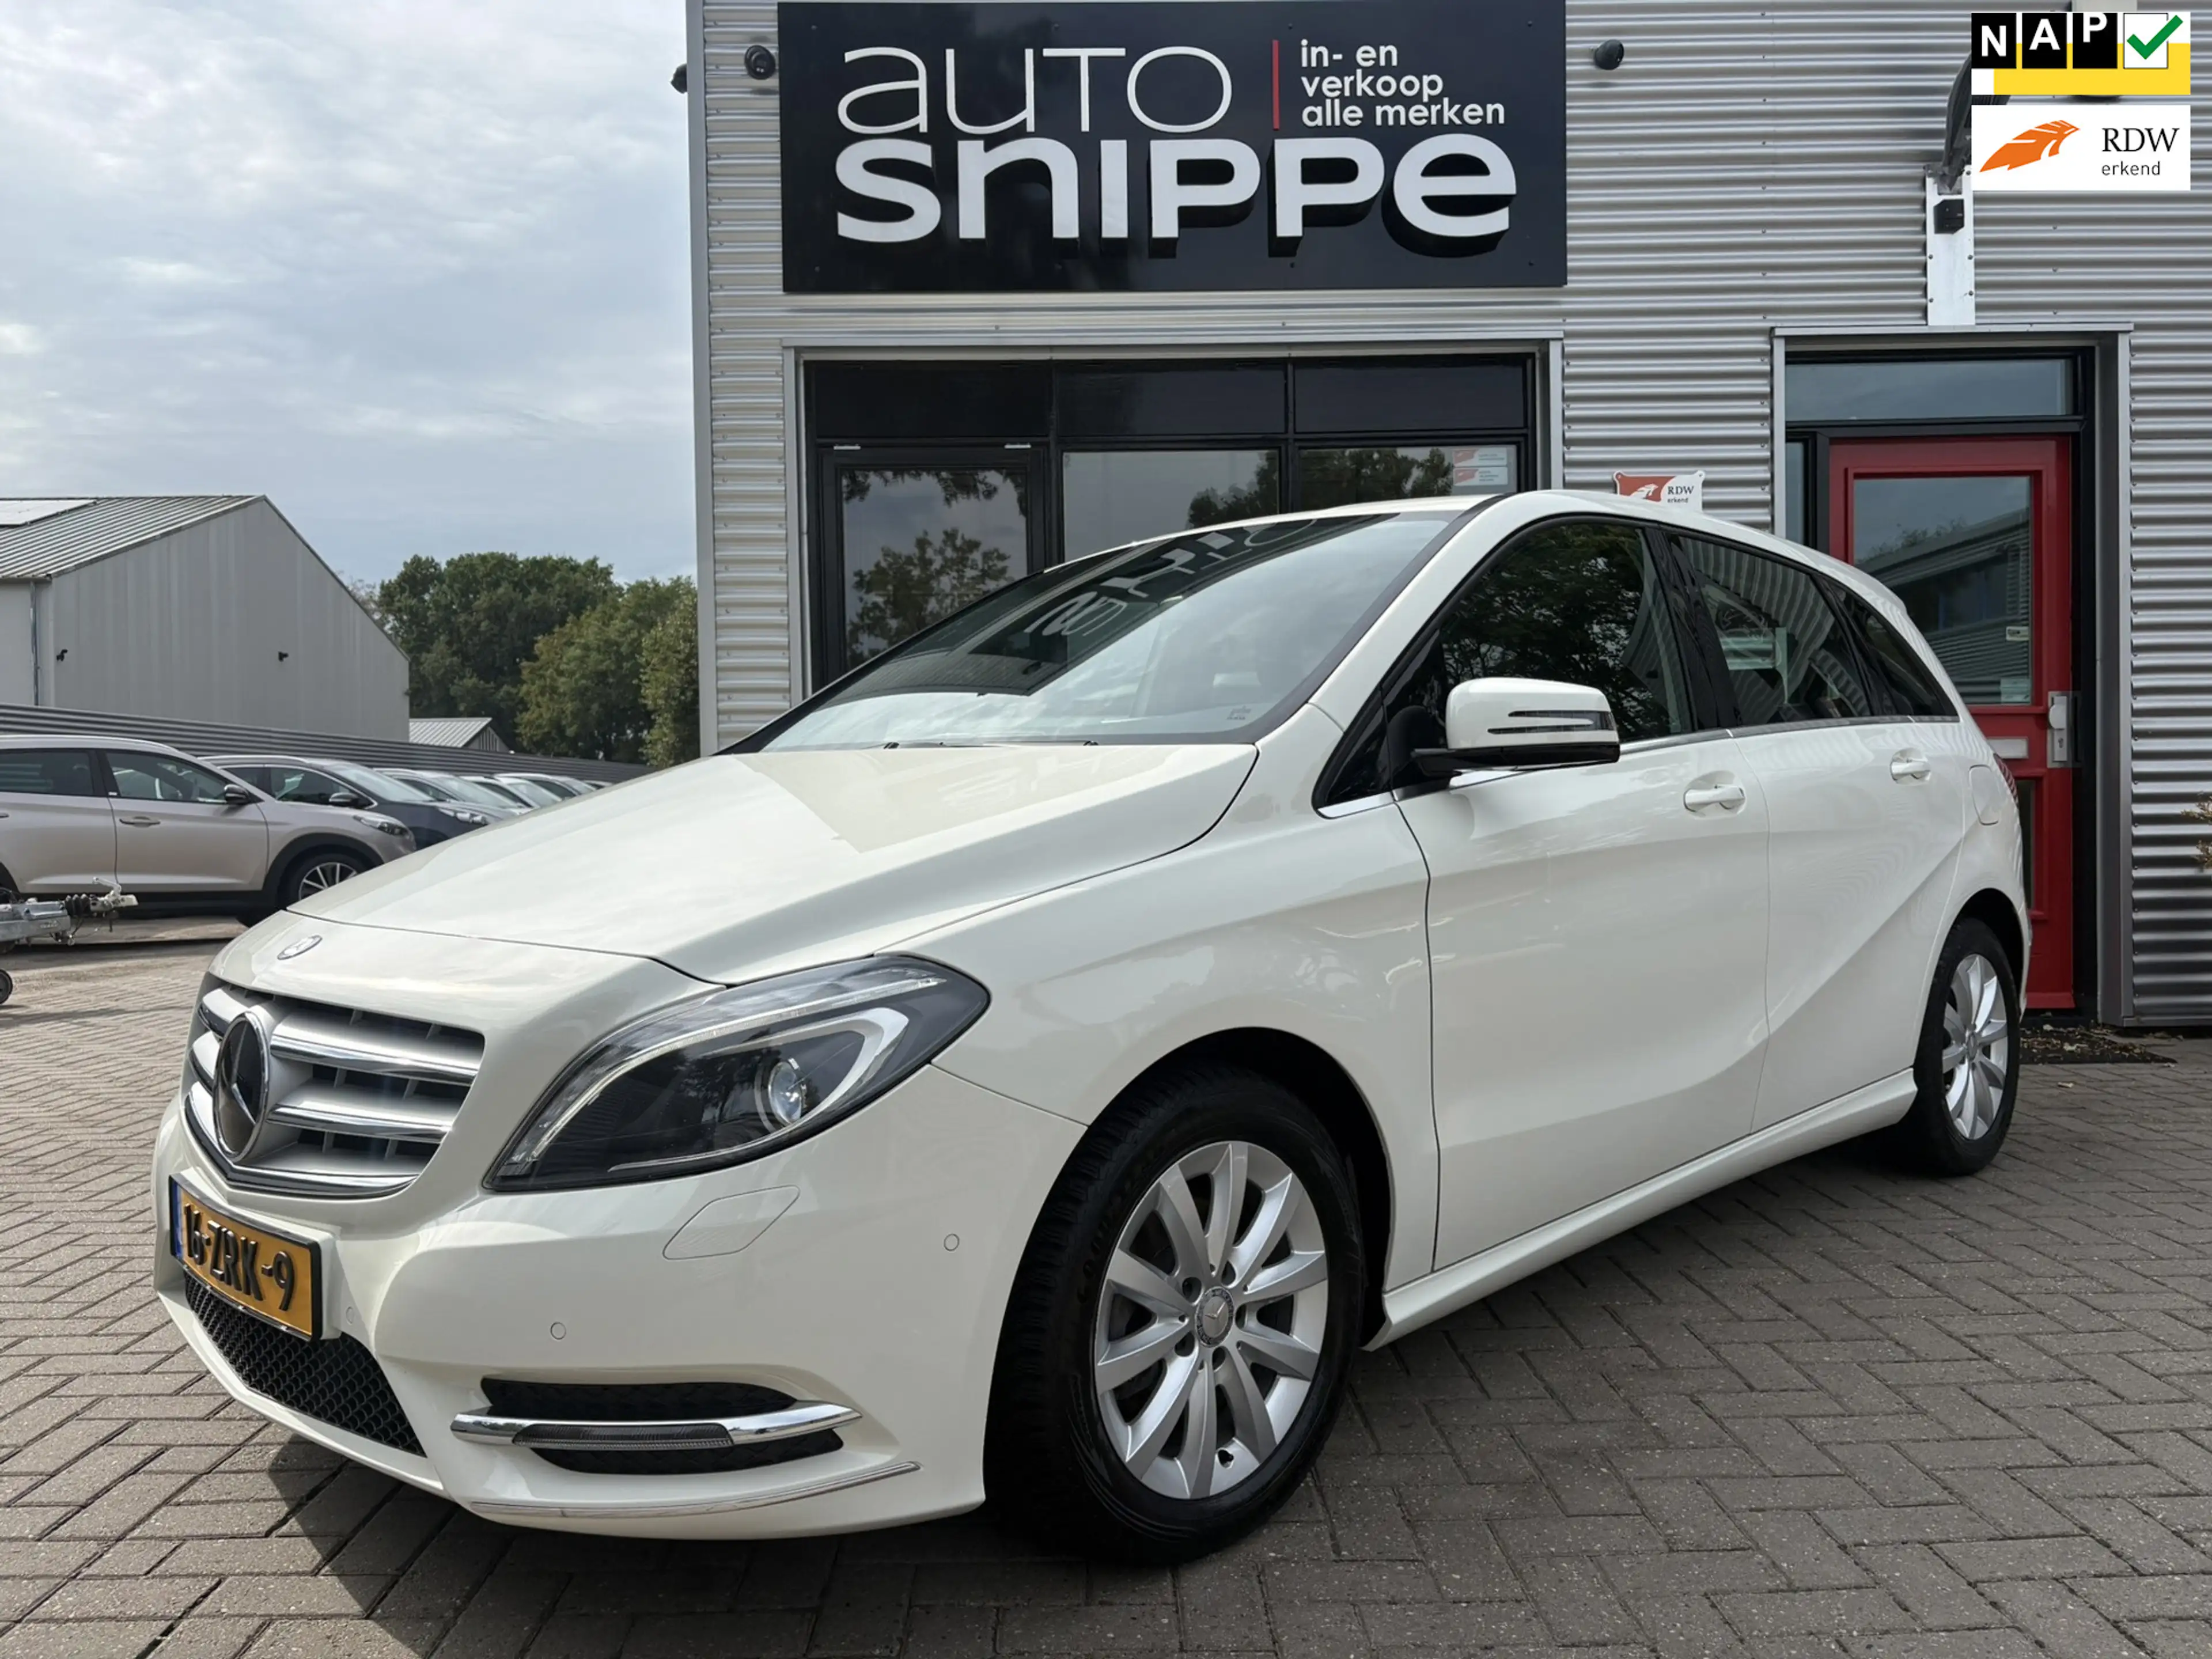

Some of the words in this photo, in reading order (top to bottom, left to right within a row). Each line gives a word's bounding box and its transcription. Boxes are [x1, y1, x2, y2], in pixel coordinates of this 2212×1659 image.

[1301, 39, 1343, 67] in-
[1356, 45, 1398, 67] en
[1301, 69, 1444, 102] verkoop
[1302, 99, 1363, 127] alle
[1376, 97, 1505, 126] merken
[1667, 486, 1694, 495] RDW
[184, 1203, 296, 1312] 16-ZRK-9
